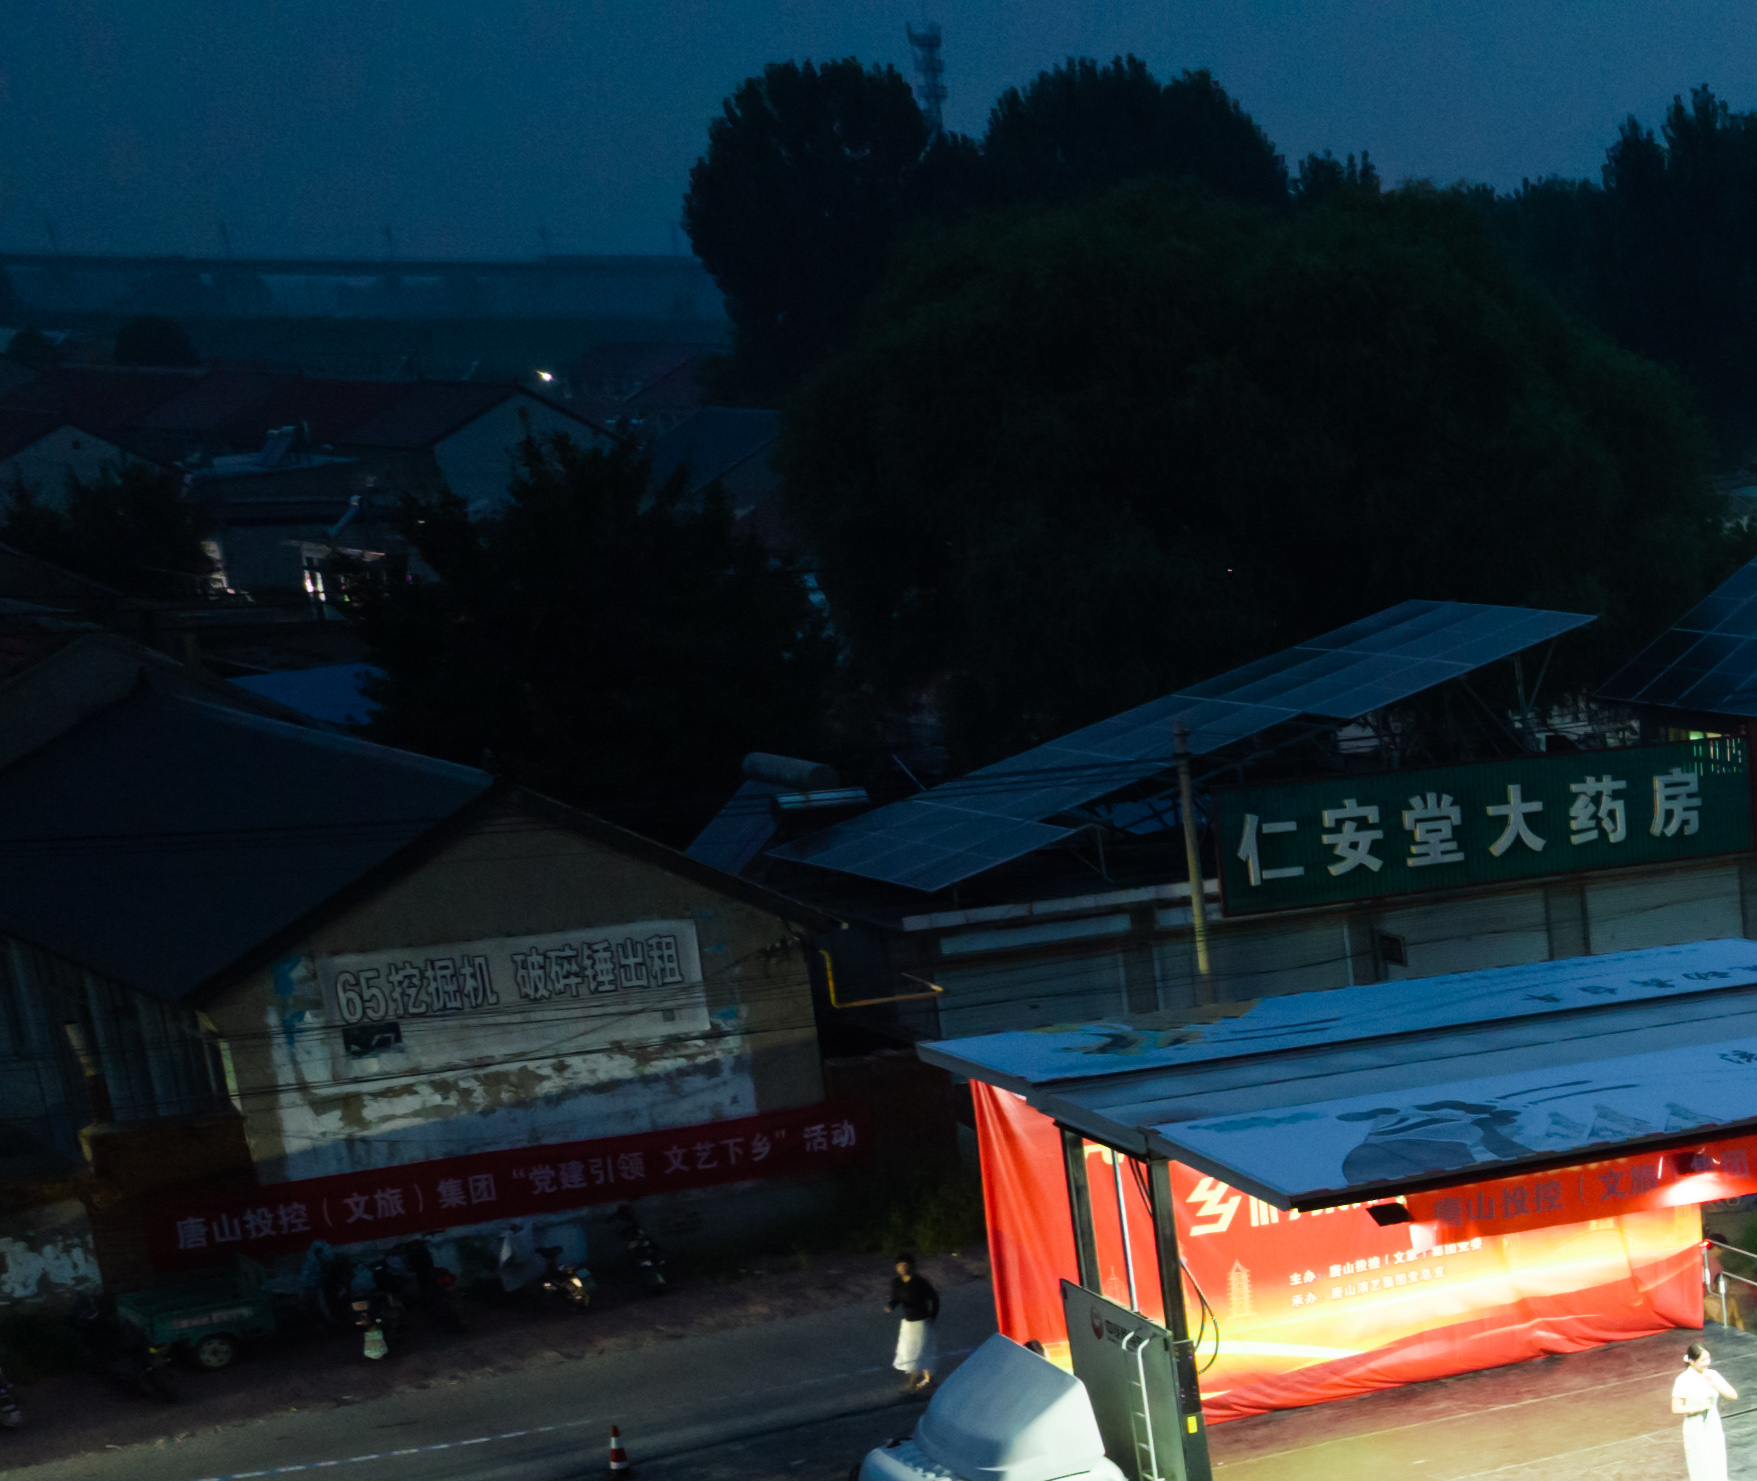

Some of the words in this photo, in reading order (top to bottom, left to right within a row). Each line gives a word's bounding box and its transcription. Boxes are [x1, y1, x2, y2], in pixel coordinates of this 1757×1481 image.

[1236, 766, 1702, 887] 仁安堂大药房
[335, 954, 499, 1026] 65挖掘机
[510, 933, 685, 1000] 破碎锤出租
